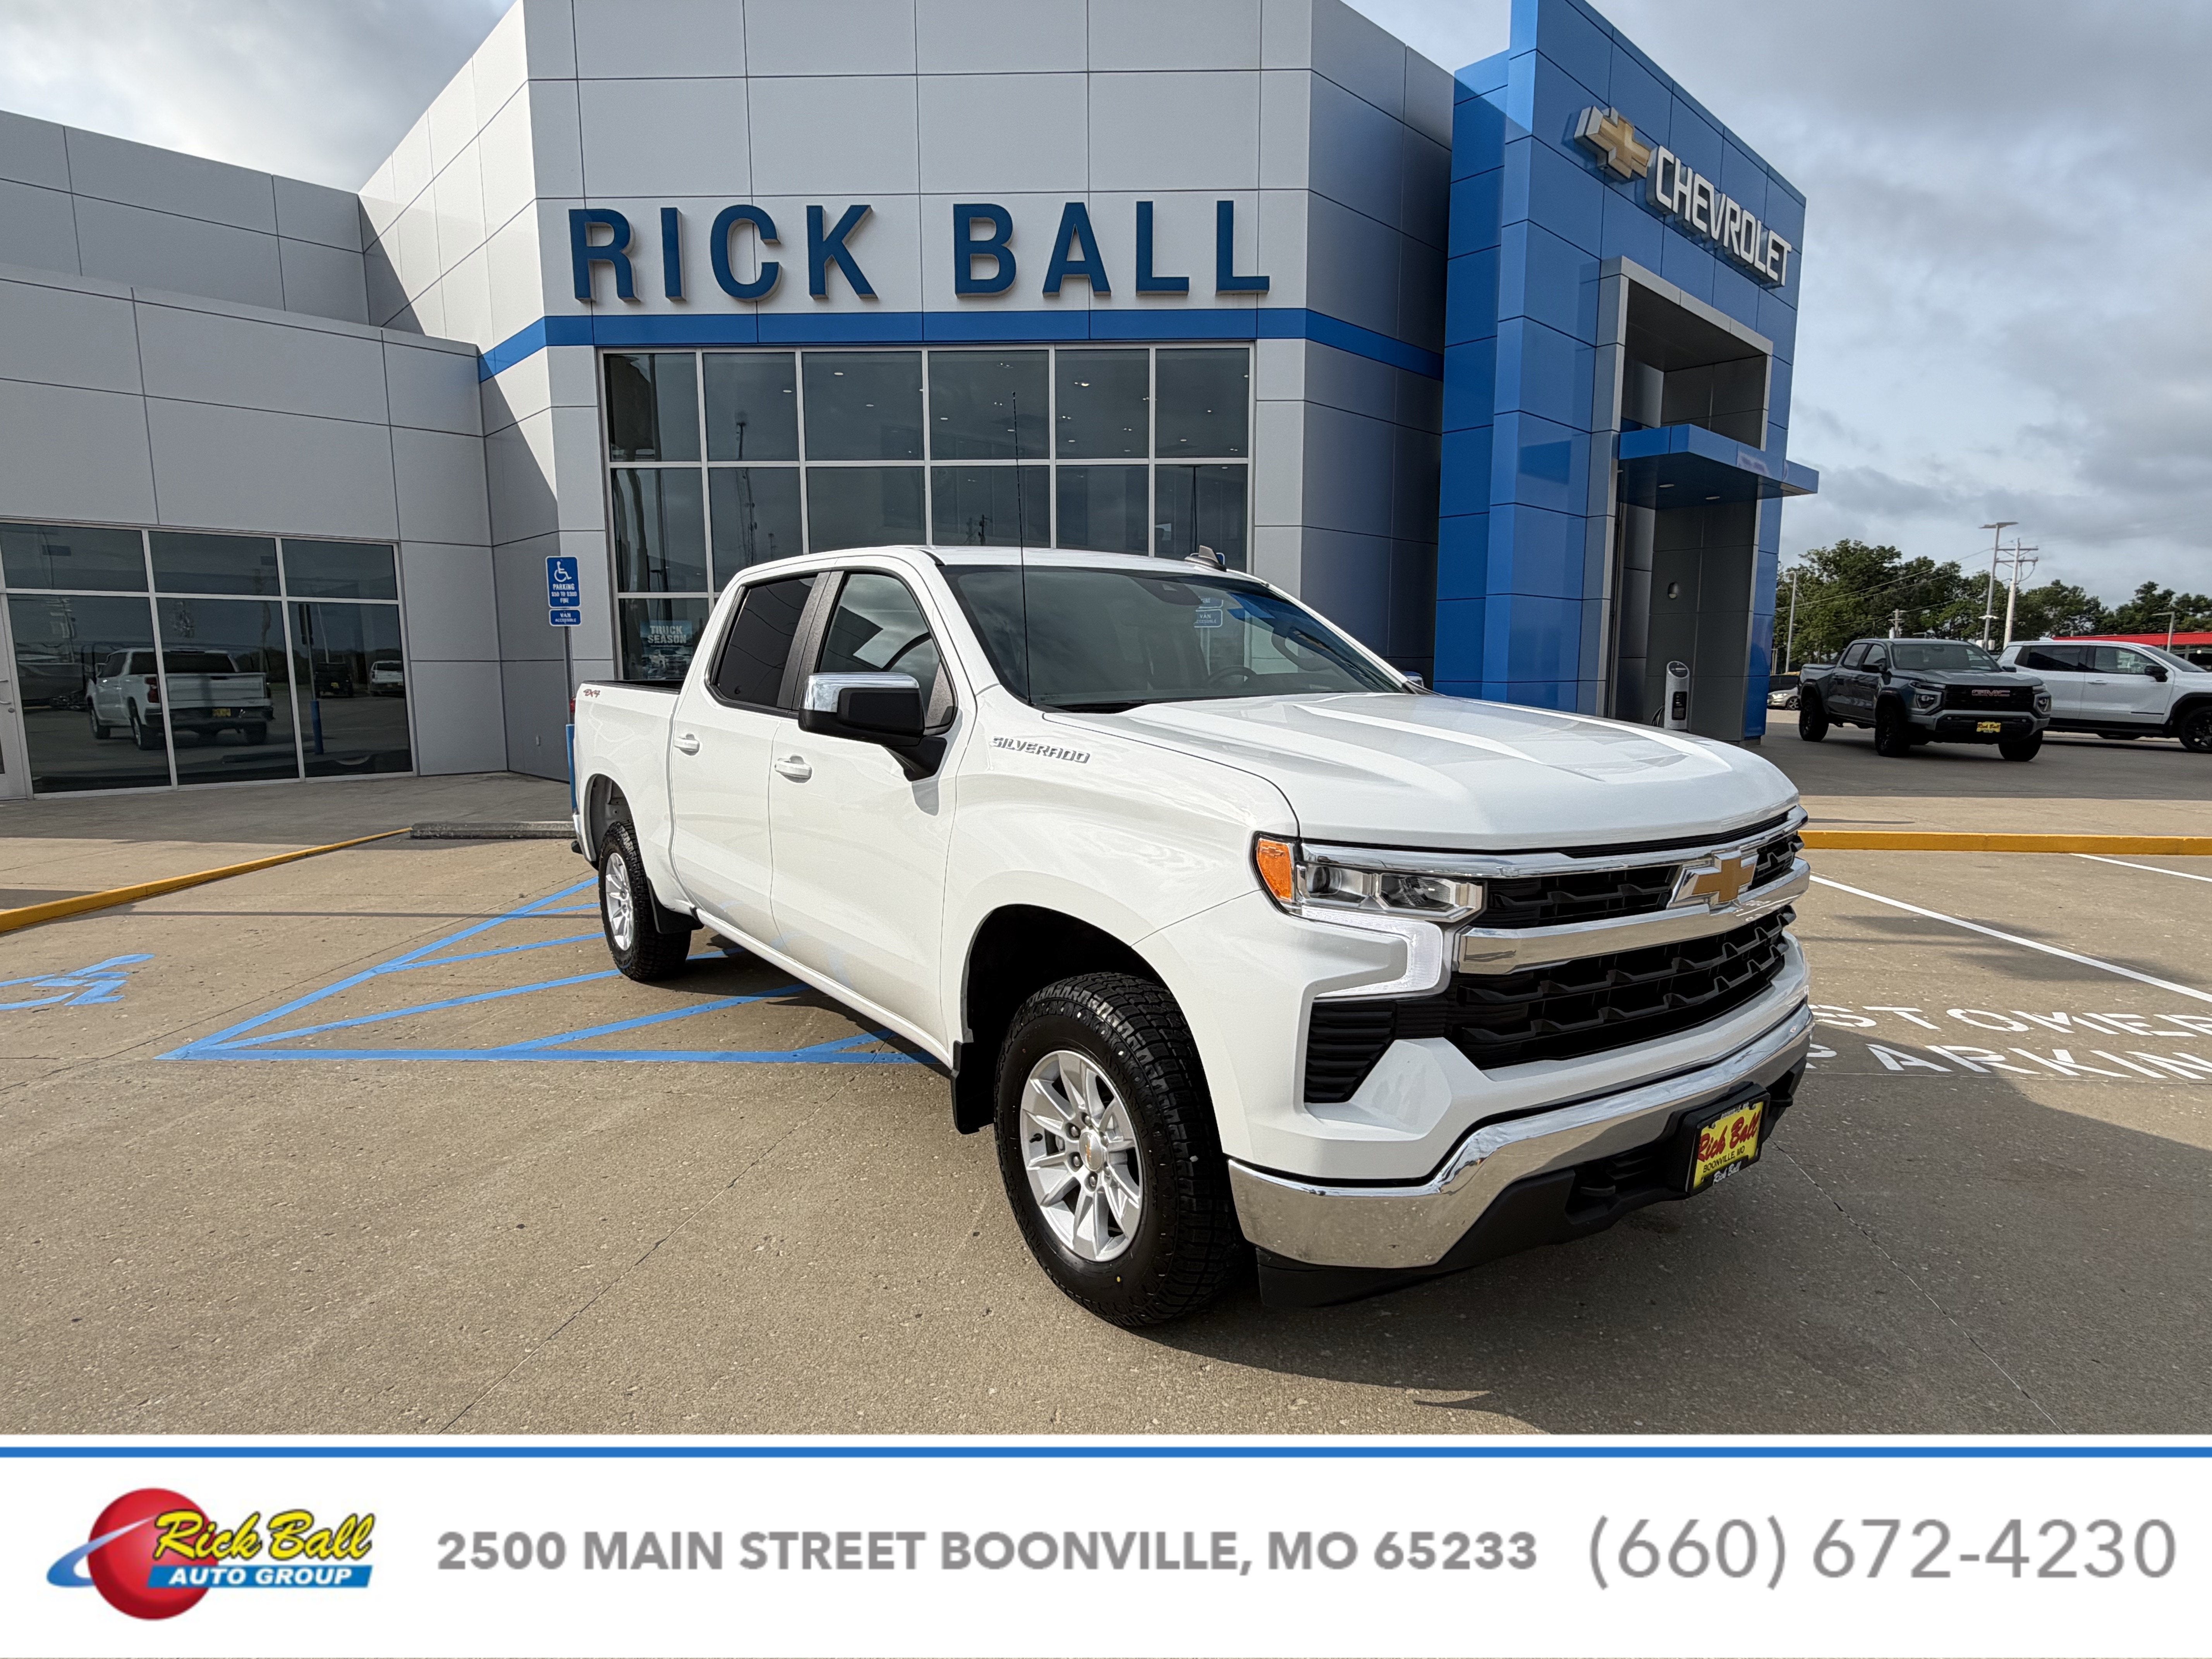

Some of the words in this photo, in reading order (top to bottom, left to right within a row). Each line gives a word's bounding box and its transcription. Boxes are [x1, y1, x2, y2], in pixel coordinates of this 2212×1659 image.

[1649, 145, 1792, 287] CHEVROLET
[568, 204, 878, 304] RICK
[953, 200, 1270, 299] BALL
[647, 634, 687, 644] SEASON
[650, 625, 683, 635] TRUCK
[992, 736, 1091, 764] SILVERADO
[1697, 1125, 1728, 1162] Rick
[1729, 1110, 1761, 1149] Ball
